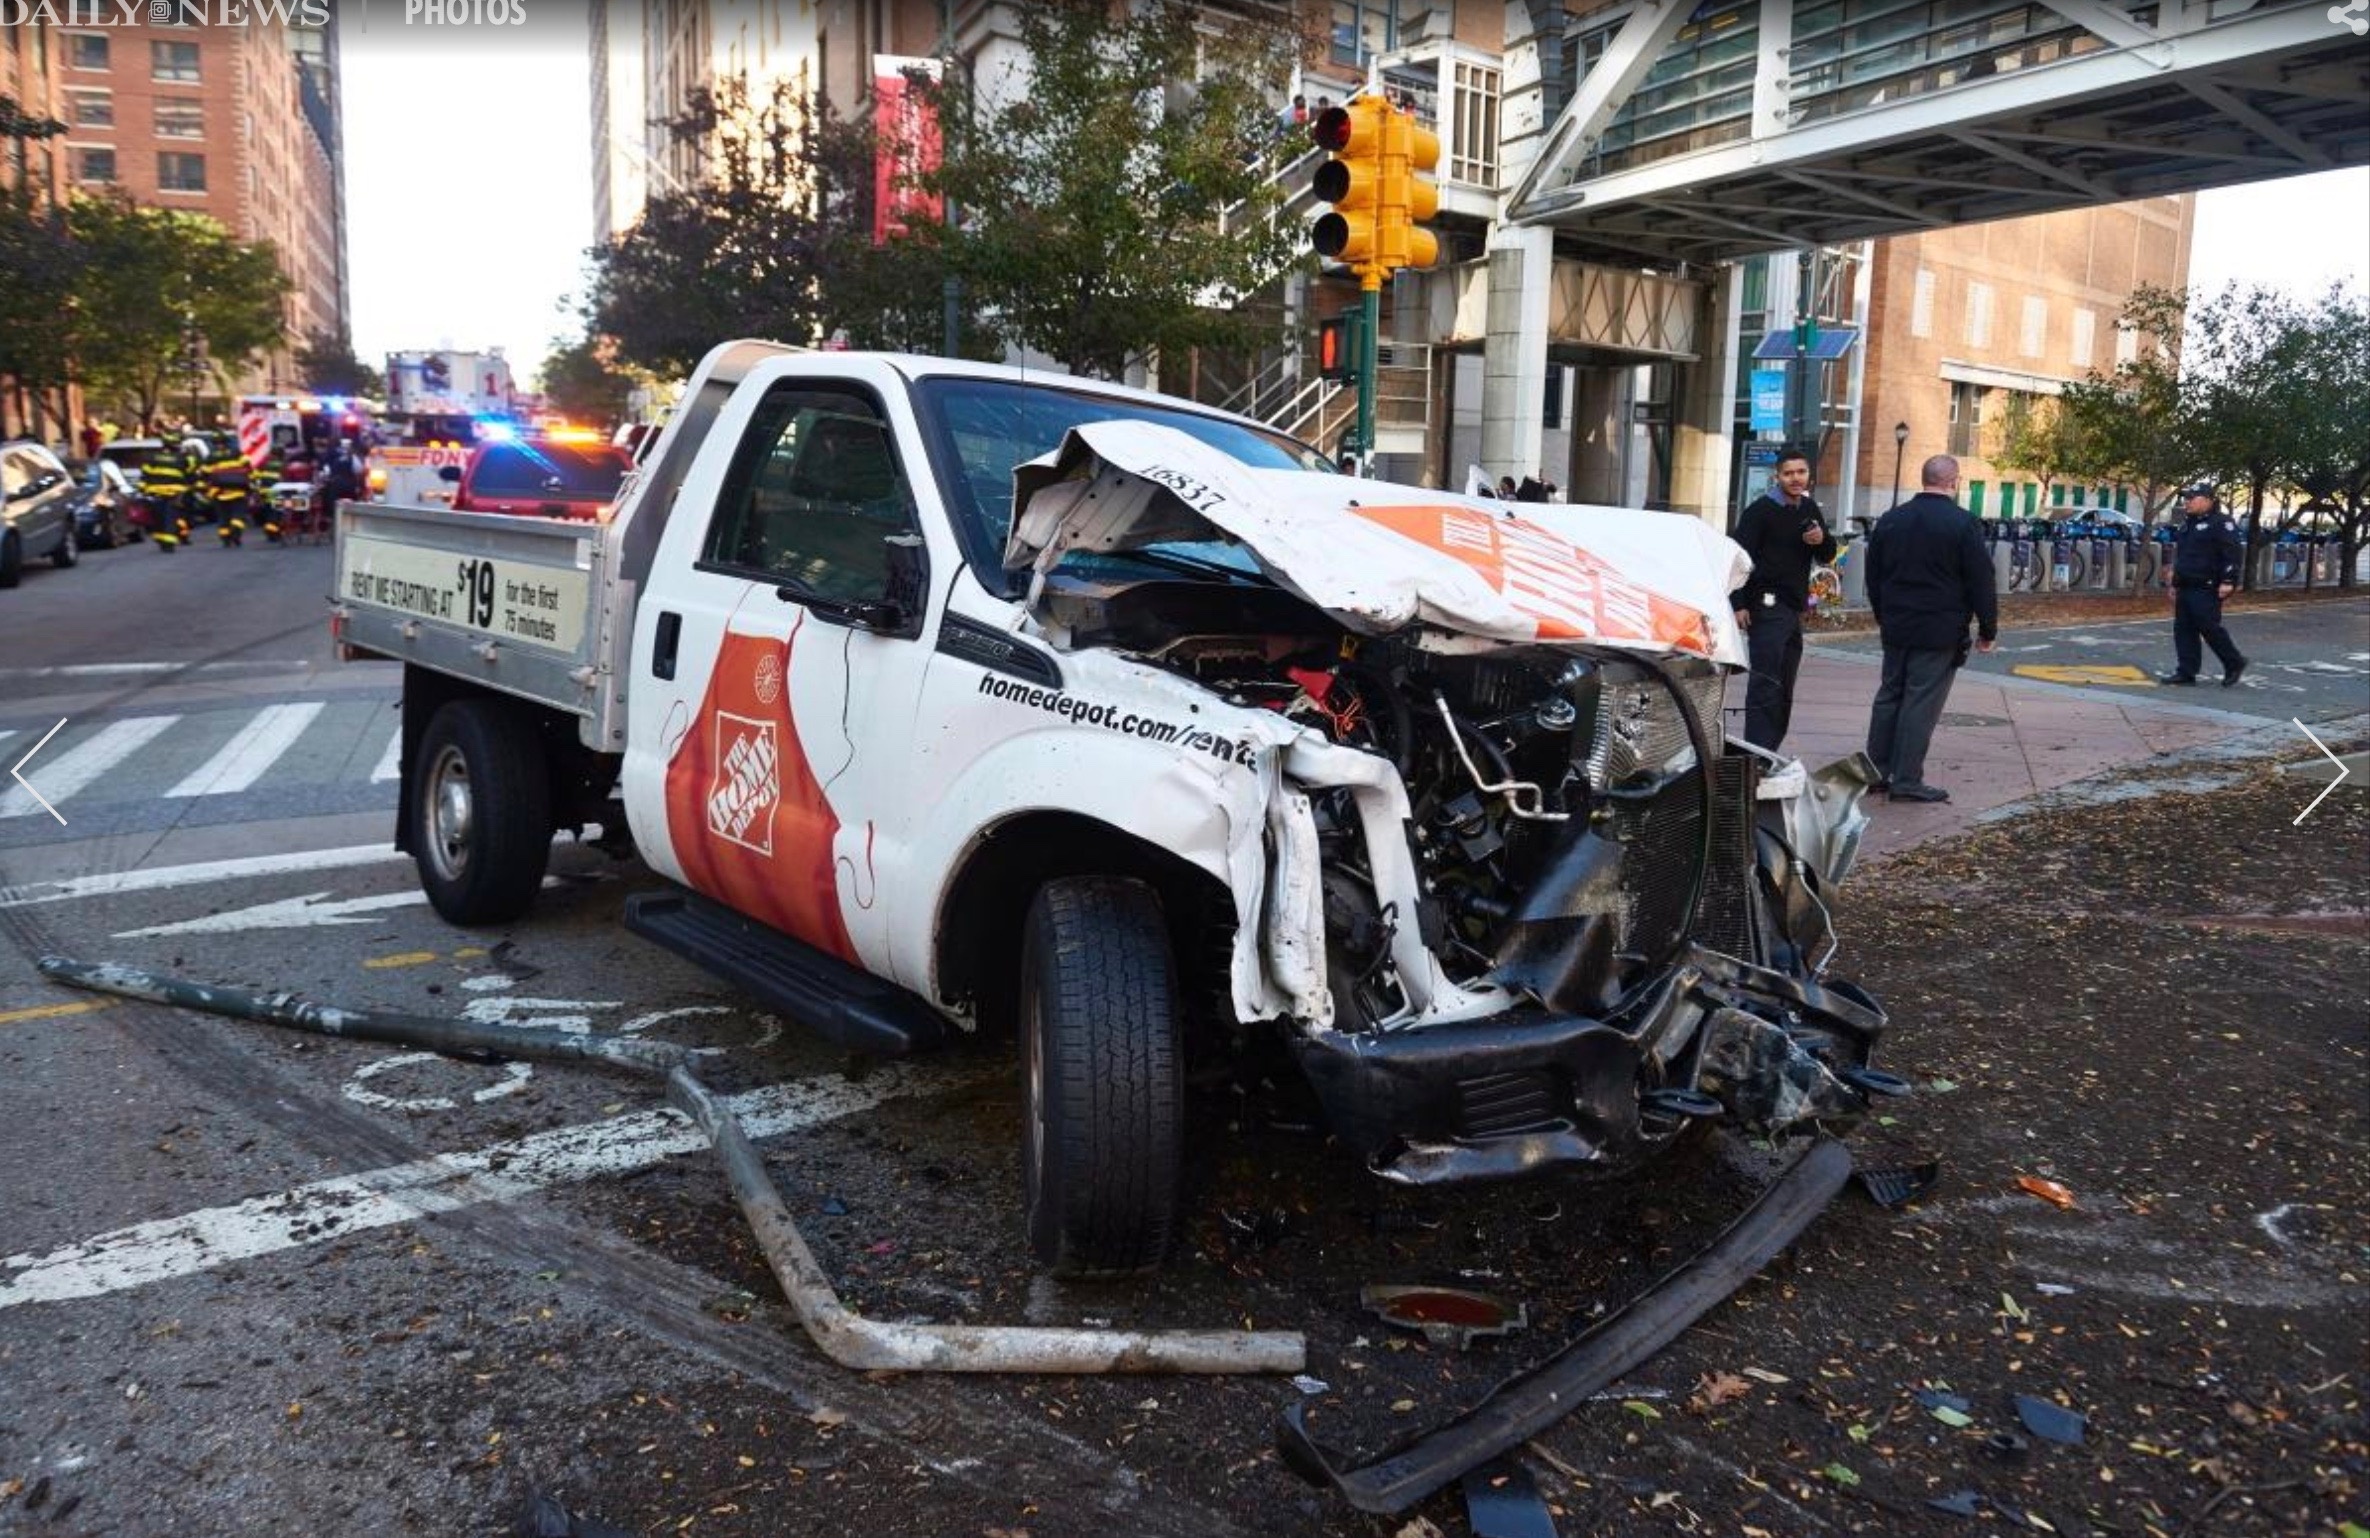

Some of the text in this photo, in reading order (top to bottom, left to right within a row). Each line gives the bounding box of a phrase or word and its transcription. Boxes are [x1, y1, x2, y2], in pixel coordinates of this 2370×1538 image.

[1139, 464, 1227, 511] 16837
[352, 571, 374, 599] RENT
[391, 579, 437, 616] STARTING
[440, 590, 454, 618] AT
[506, 579, 559, 611] for the first
[505, 609, 556, 642] 75 minutes
[709, 725, 776, 833] HOME
